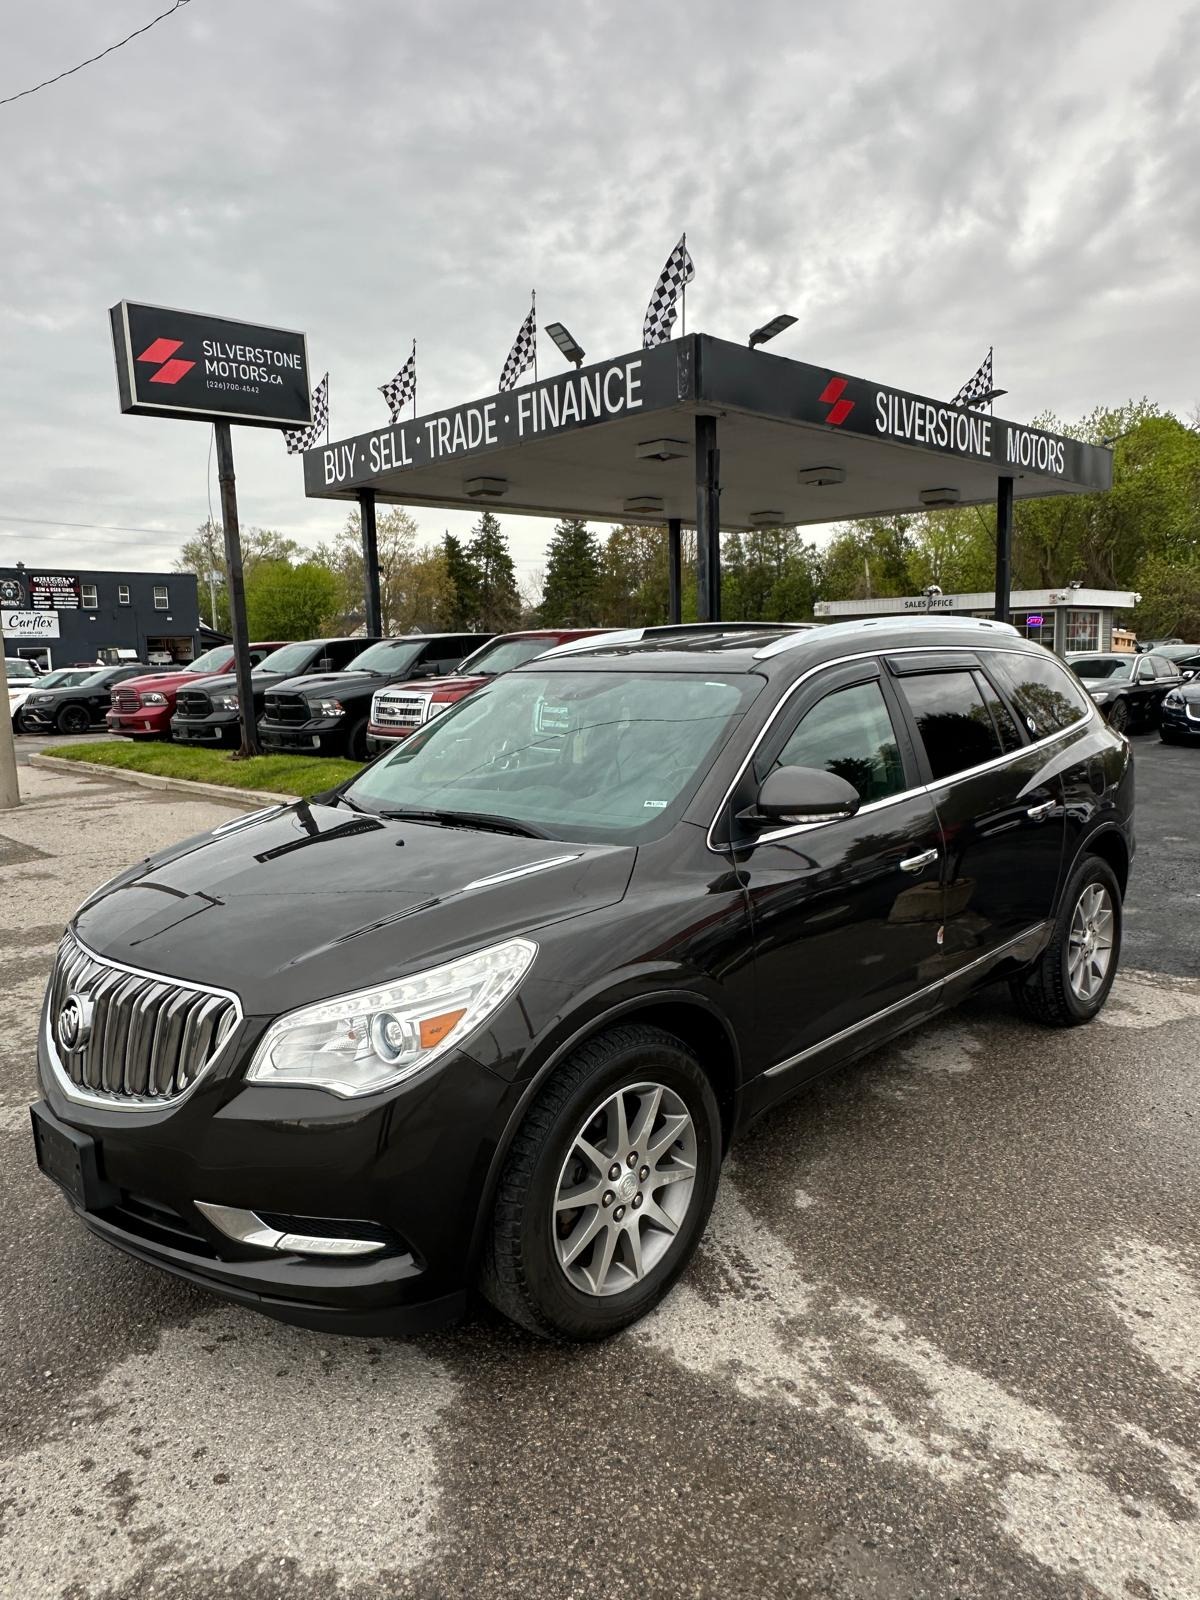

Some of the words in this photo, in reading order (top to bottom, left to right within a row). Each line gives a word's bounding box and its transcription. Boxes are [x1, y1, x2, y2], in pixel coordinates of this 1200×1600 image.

[202, 340, 302, 370] SILVERSTONE
[324, 443, 357, 485] BUY
[369, 429, 413, 473] SELL
[424, 402, 498, 458] TRADE
[517, 360, 643, 436] FINANCE
[875, 391, 992, 457] SILVERSTONE
[1007, 427, 1065, 474] MOTORS
[904, 600, 926, 609] SALES
[928, 599, 953, 607] OFFICE
[9, 614, 53, 631] Carflex
